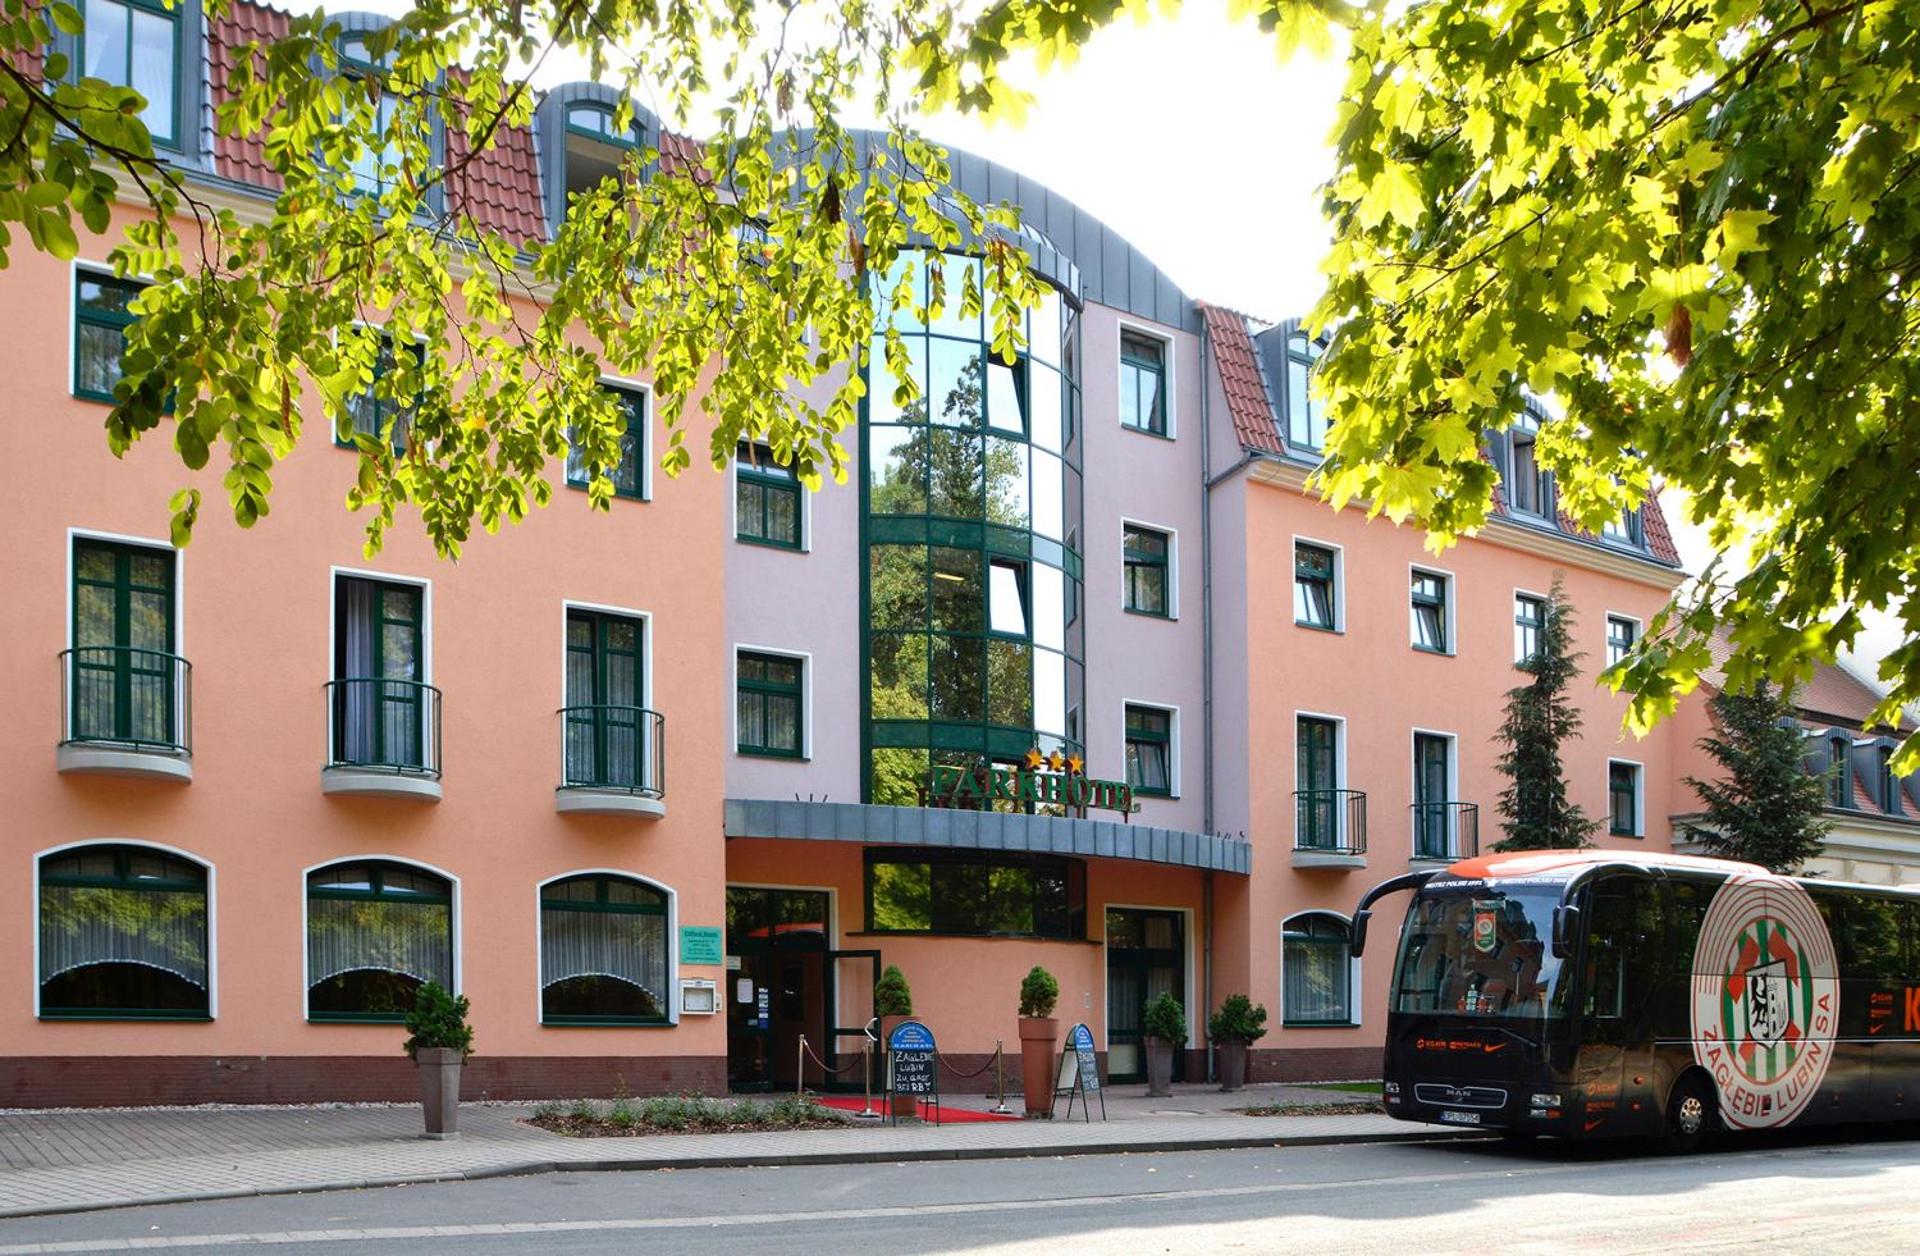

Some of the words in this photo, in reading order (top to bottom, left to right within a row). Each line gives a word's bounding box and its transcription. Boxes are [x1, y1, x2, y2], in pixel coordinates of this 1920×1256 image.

[932, 764, 1142, 814] PARKHOTEL
[900, 1063, 925, 1072] LUBIN
[1777, 1041, 1823, 1110] LUBIN
[1816, 993, 1830, 1033] SA
